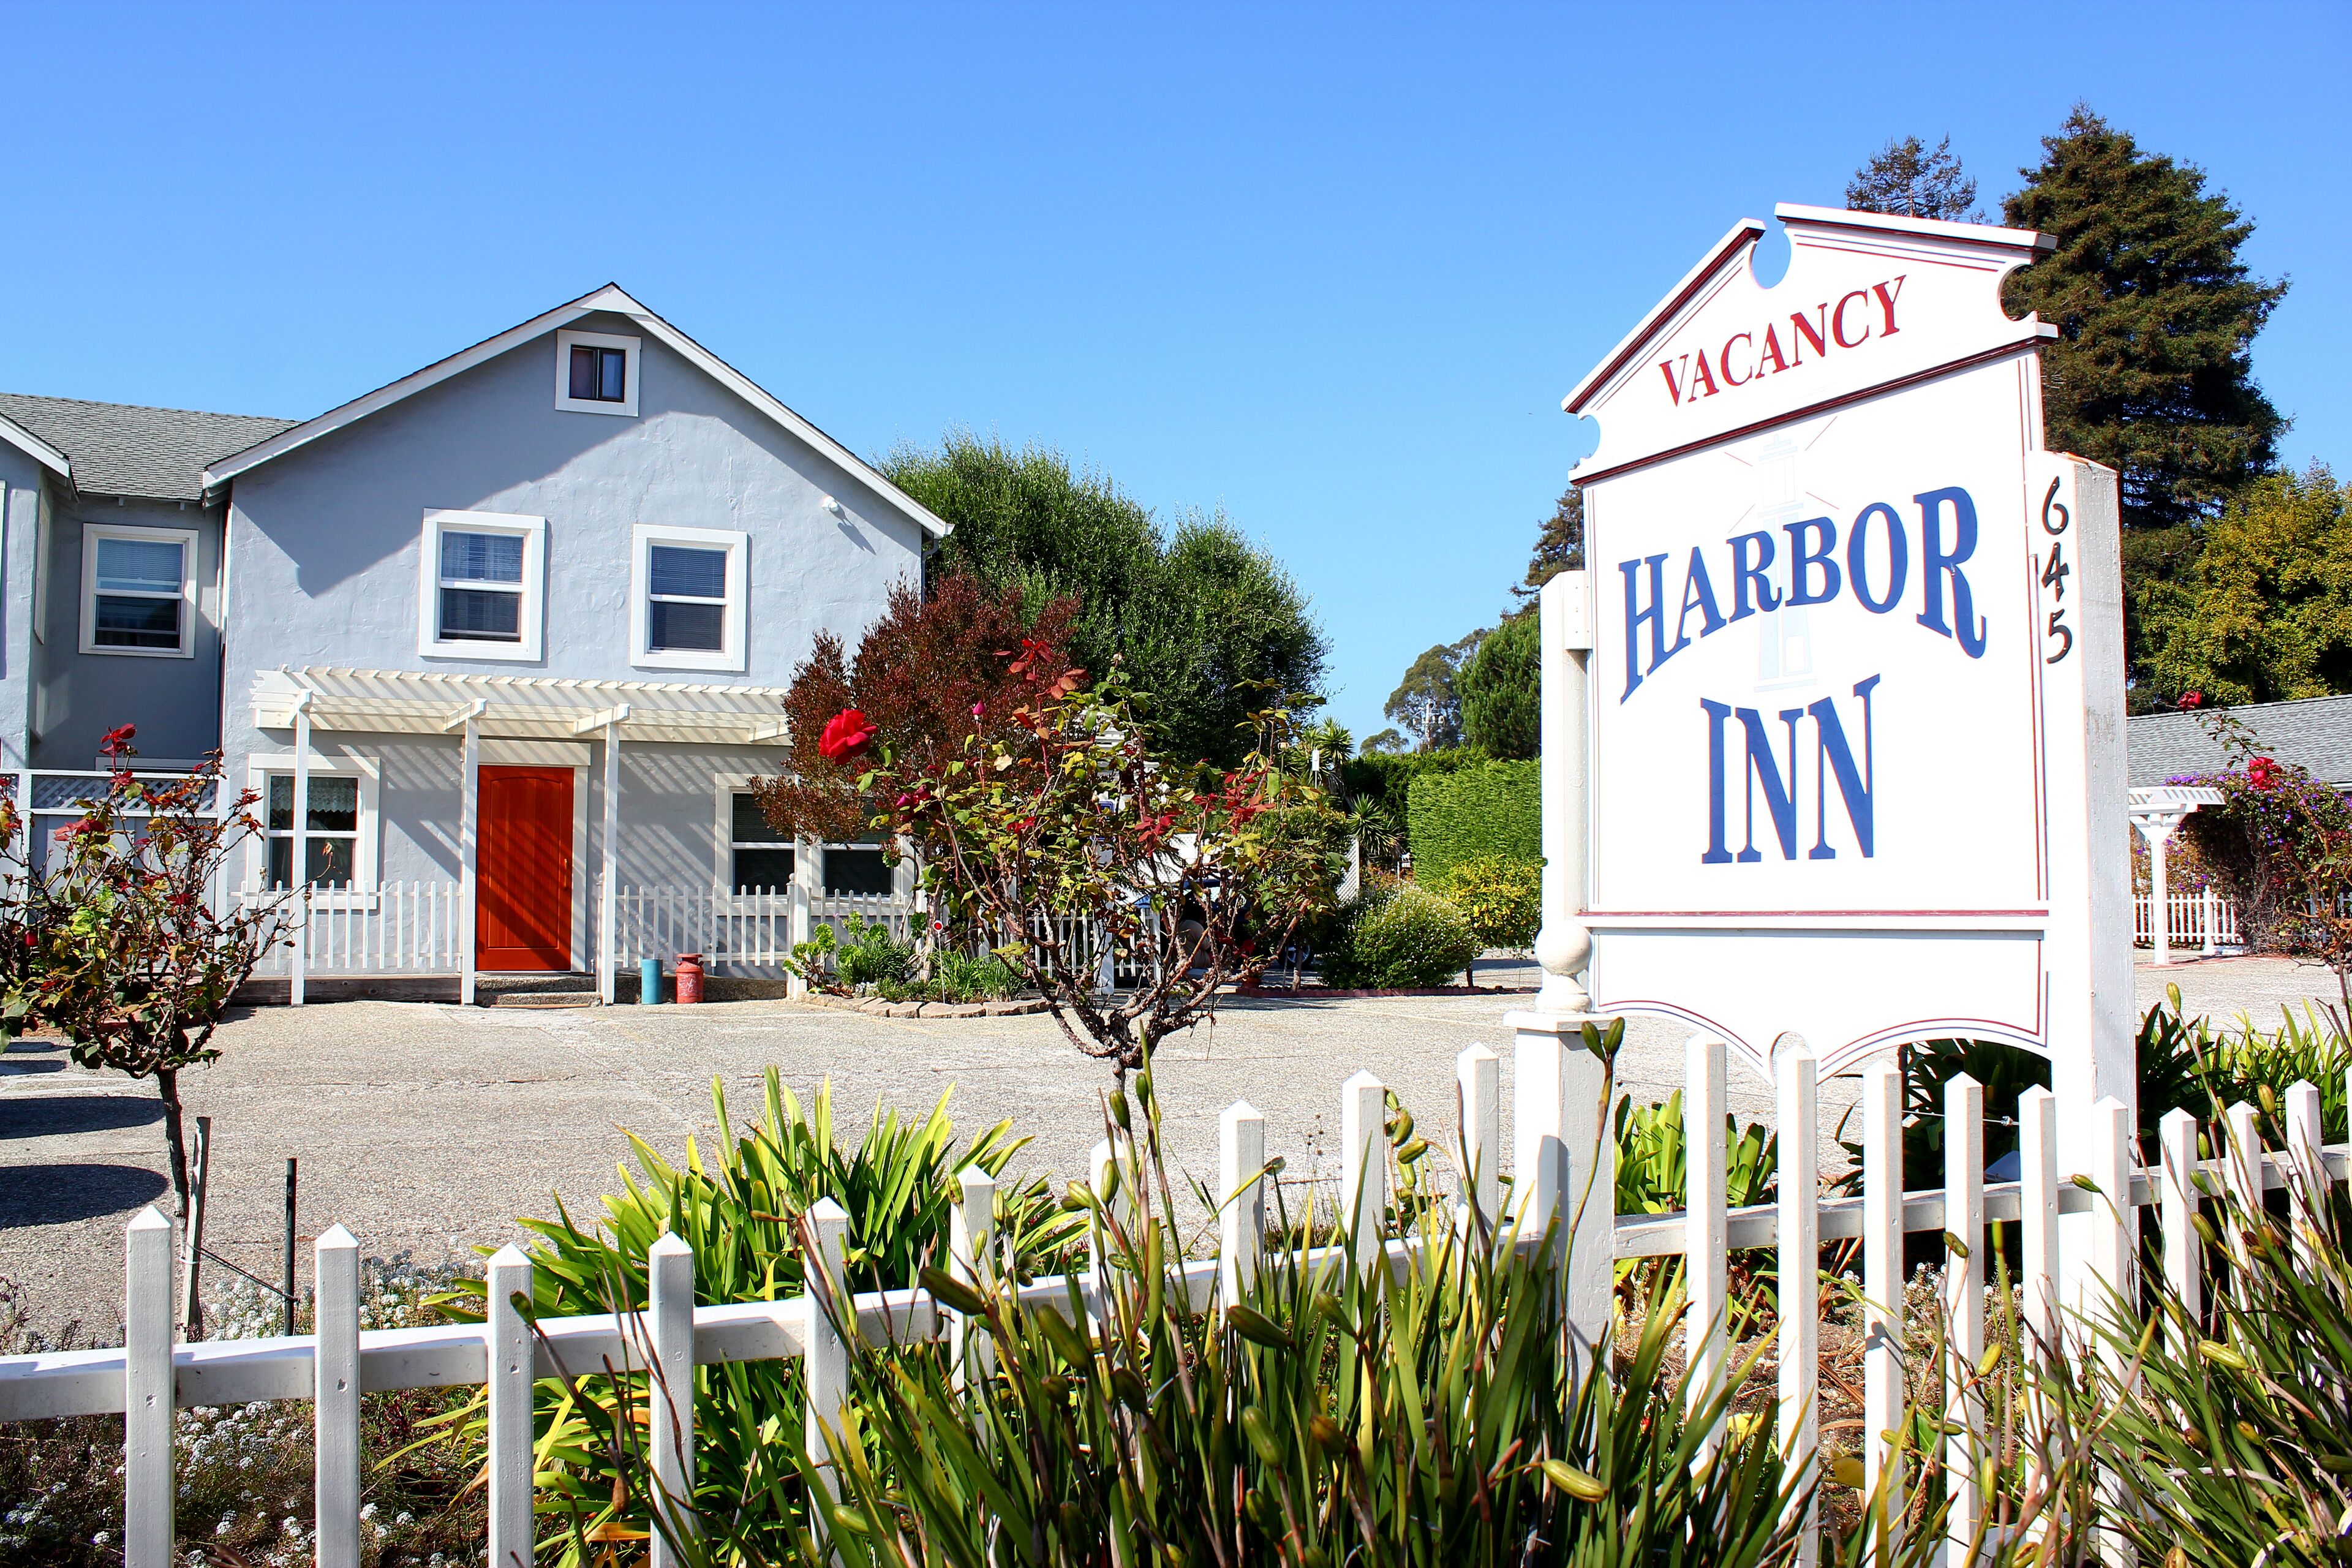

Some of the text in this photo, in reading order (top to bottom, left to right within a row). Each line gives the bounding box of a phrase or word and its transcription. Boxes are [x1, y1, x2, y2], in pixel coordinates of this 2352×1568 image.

[1658, 274, 1907, 407] VACANCY
[1618, 486, 1987, 705] HARBOR
[2041, 475, 2073, 664] 645
[1700, 673, 1880, 864] INN
